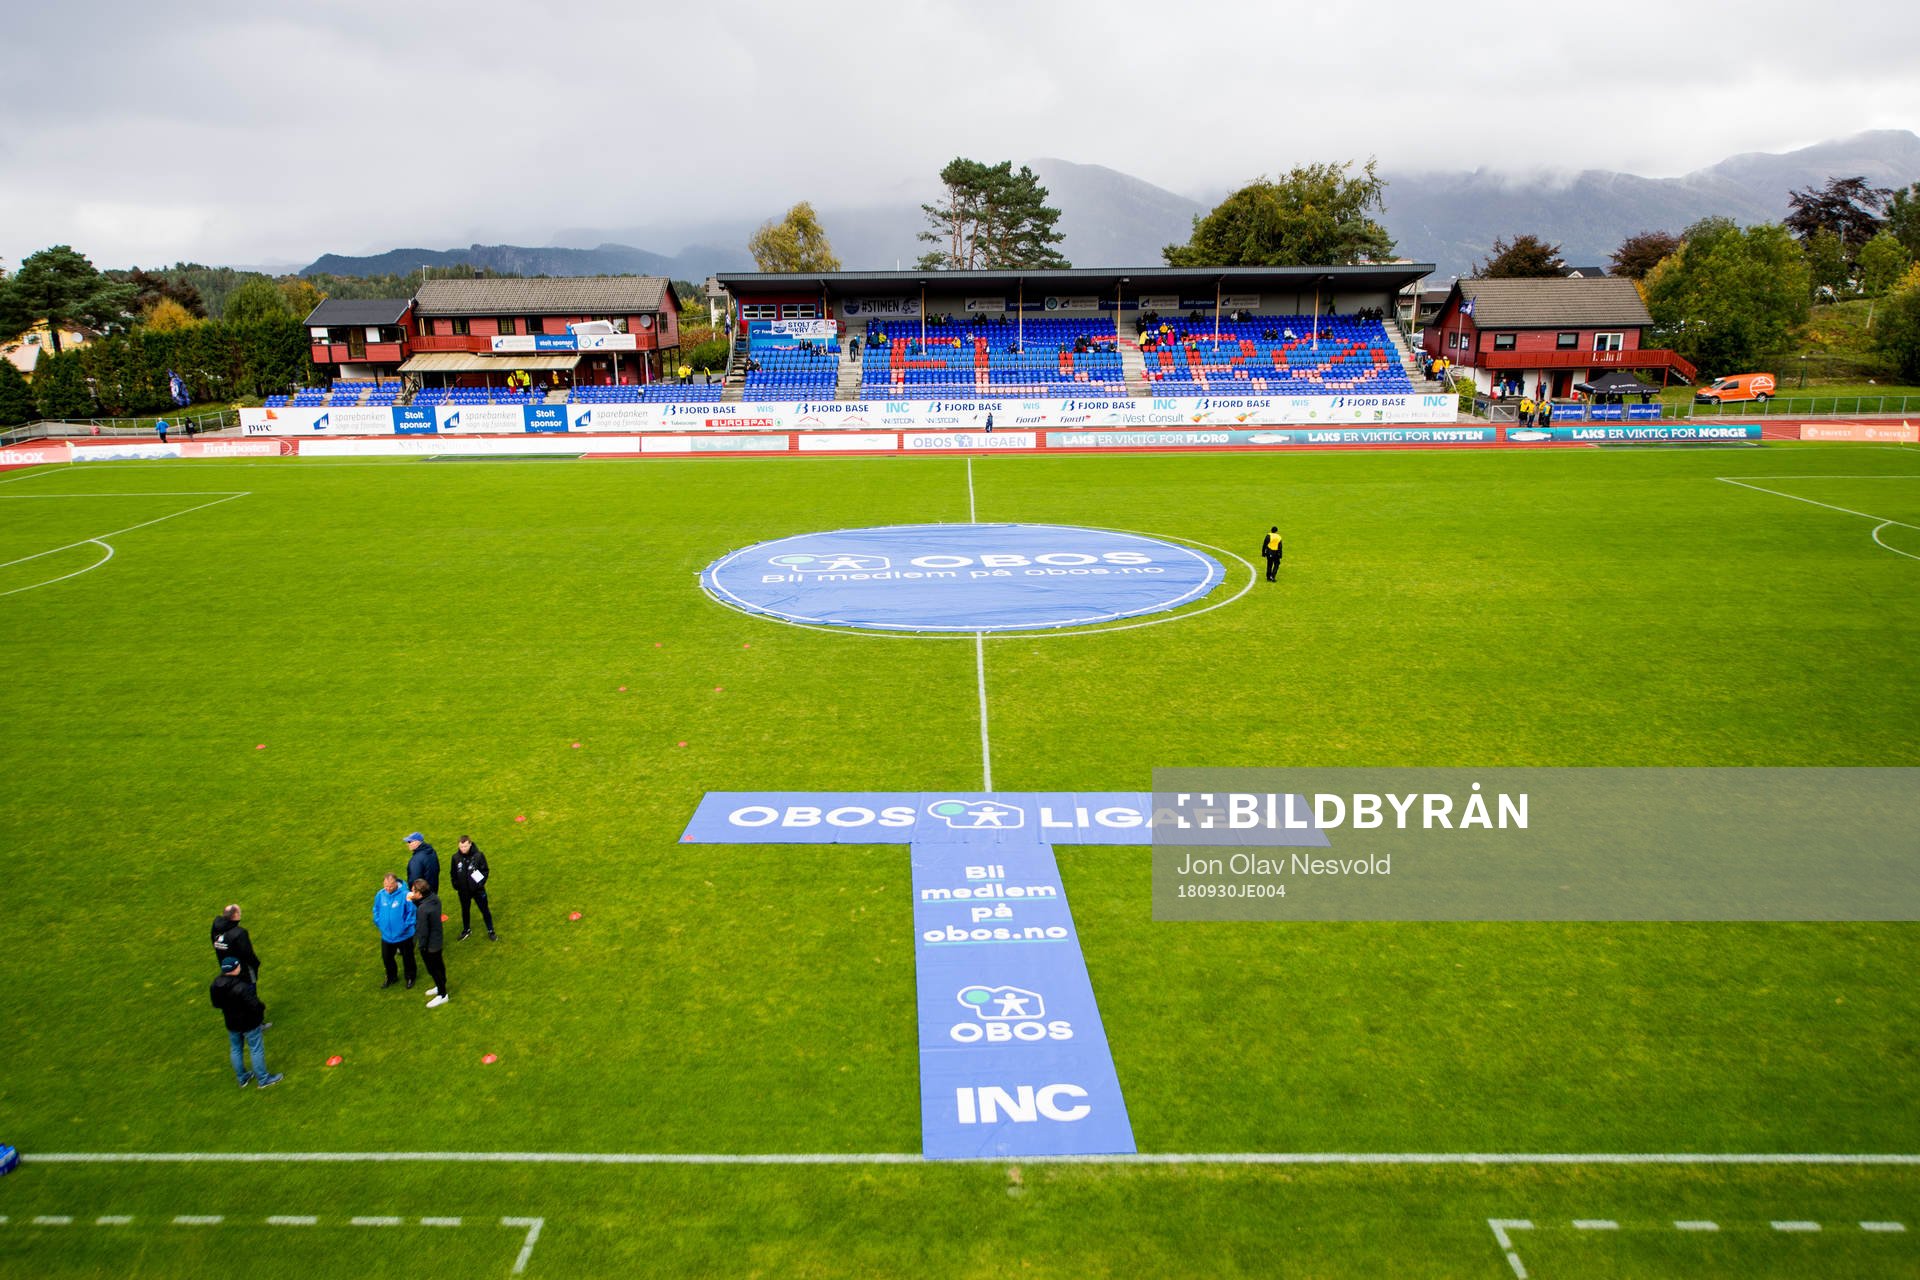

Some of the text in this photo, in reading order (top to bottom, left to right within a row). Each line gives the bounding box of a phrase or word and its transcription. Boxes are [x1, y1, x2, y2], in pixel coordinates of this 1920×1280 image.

[861, 299, 899, 313] #STIMEN
[944, 403, 974, 411] FJORD
[1022, 402, 1040, 410] WIS
[1078, 401, 1136, 409] FJORD BASE
[1153, 399, 1177, 410] INC
[1212, 399, 1271, 408] FJORD BASE
[1347, 398, 1406, 406] FJORD BASE
[1423, 396, 1448, 407] INC
[811, 404, 869, 413] FJORD BASE
[885, 402, 910, 413] INC
[404, 410, 425, 419] Stolt
[535, 409, 556, 418] Stolt
[597, 409, 649, 419] sparebanken
[1122, 413, 1185, 423] iVest Consult
[399, 420, 432, 430] sponsor
[530, 419, 562, 429] sponsor
[711, 418, 774, 427] EUROSPAR
[247, 424, 273, 434] pwc
[1572, 427, 1748, 439] LAKS ER VIKTIG FOR NORGE
[913, 436, 1027, 448] OBOS LIGAEN
[1063, 433, 1230, 445] LAKS ER VIKTIG FOR FLORØ
[1308, 431, 1484, 442] LAKS ER VIKTIG FOR KYSTEN
[910, 552, 1153, 568] OBOS
[761, 567, 1165, 583] Bli medlem på obos.no
[728, 806, 917, 828] OBOS
[965, 864, 1006, 880] Bli
[921, 883, 1058, 900] medlem
[970, 902, 1014, 923] på
[923, 924, 1069, 943] obos.no
[950, 1020, 1074, 1043] OBOS
[956, 1083, 1092, 1124] INC
